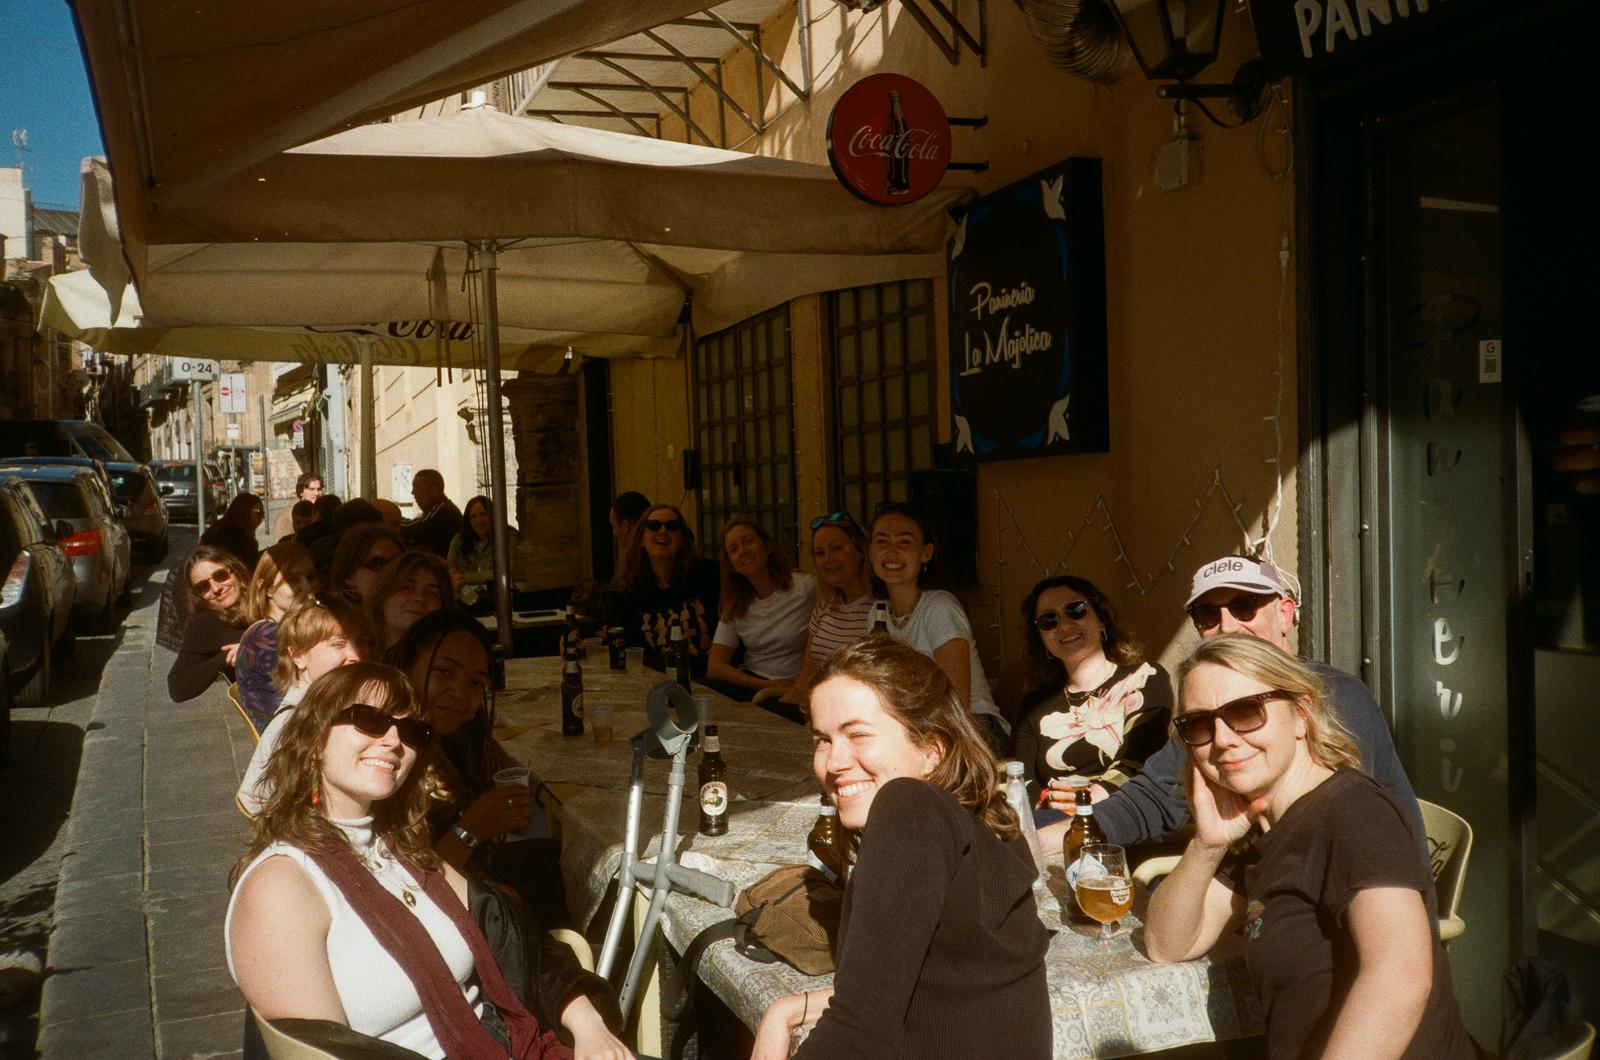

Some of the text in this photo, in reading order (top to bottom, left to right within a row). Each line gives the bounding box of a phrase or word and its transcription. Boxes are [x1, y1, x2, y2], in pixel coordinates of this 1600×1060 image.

[1294, 0, 1430, 58] PAN
[969, 282, 1034, 320] Panineria
[960, 316, 1052, 376] La Majolica
[1203, 560, 1243, 578] ciele
